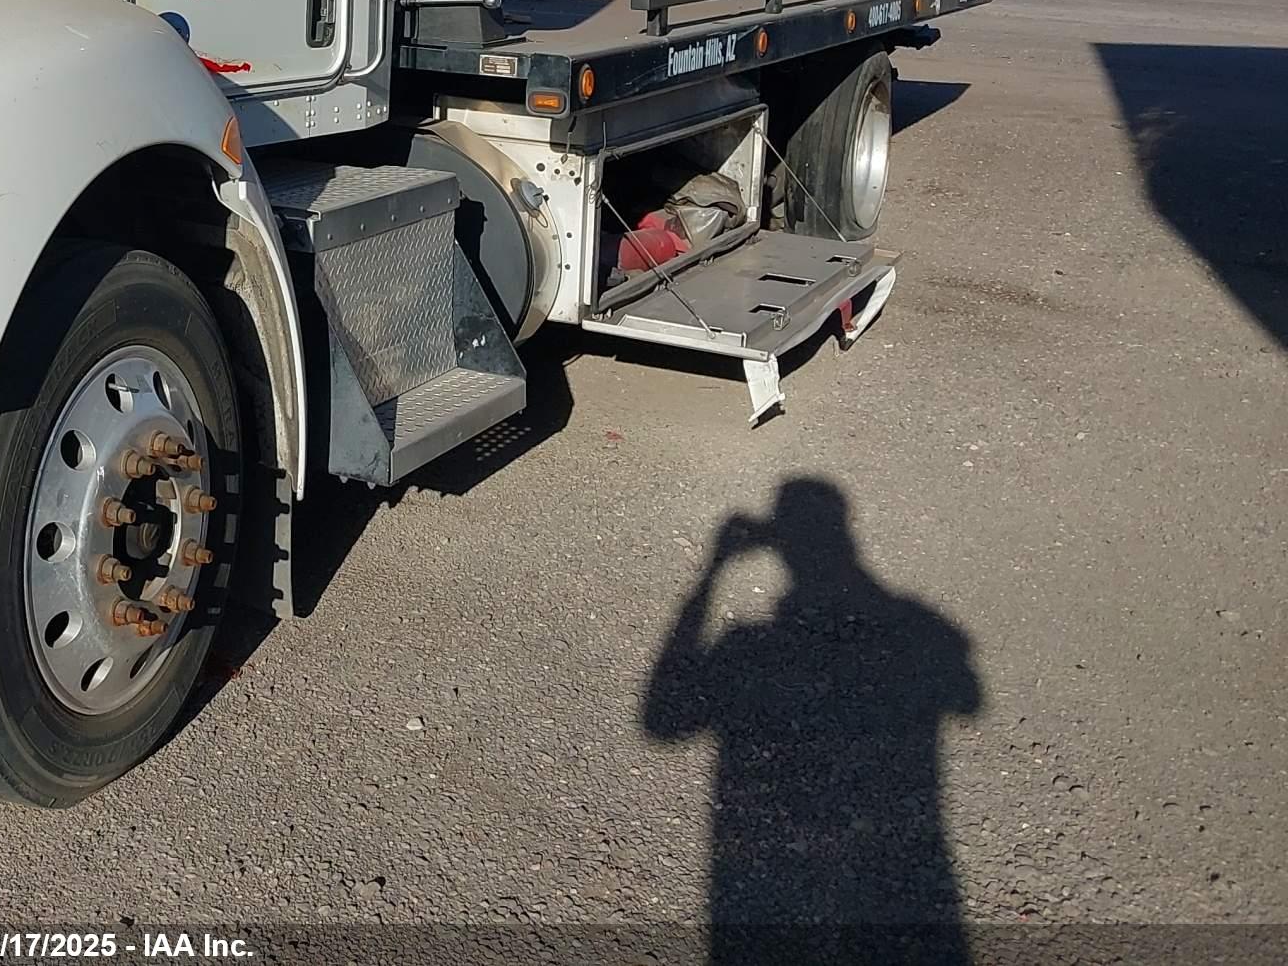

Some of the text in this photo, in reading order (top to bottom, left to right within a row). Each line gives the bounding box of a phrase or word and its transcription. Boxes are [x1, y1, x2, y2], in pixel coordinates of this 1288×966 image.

[667, 33, 737, 77] Fountain Hills, AZ
